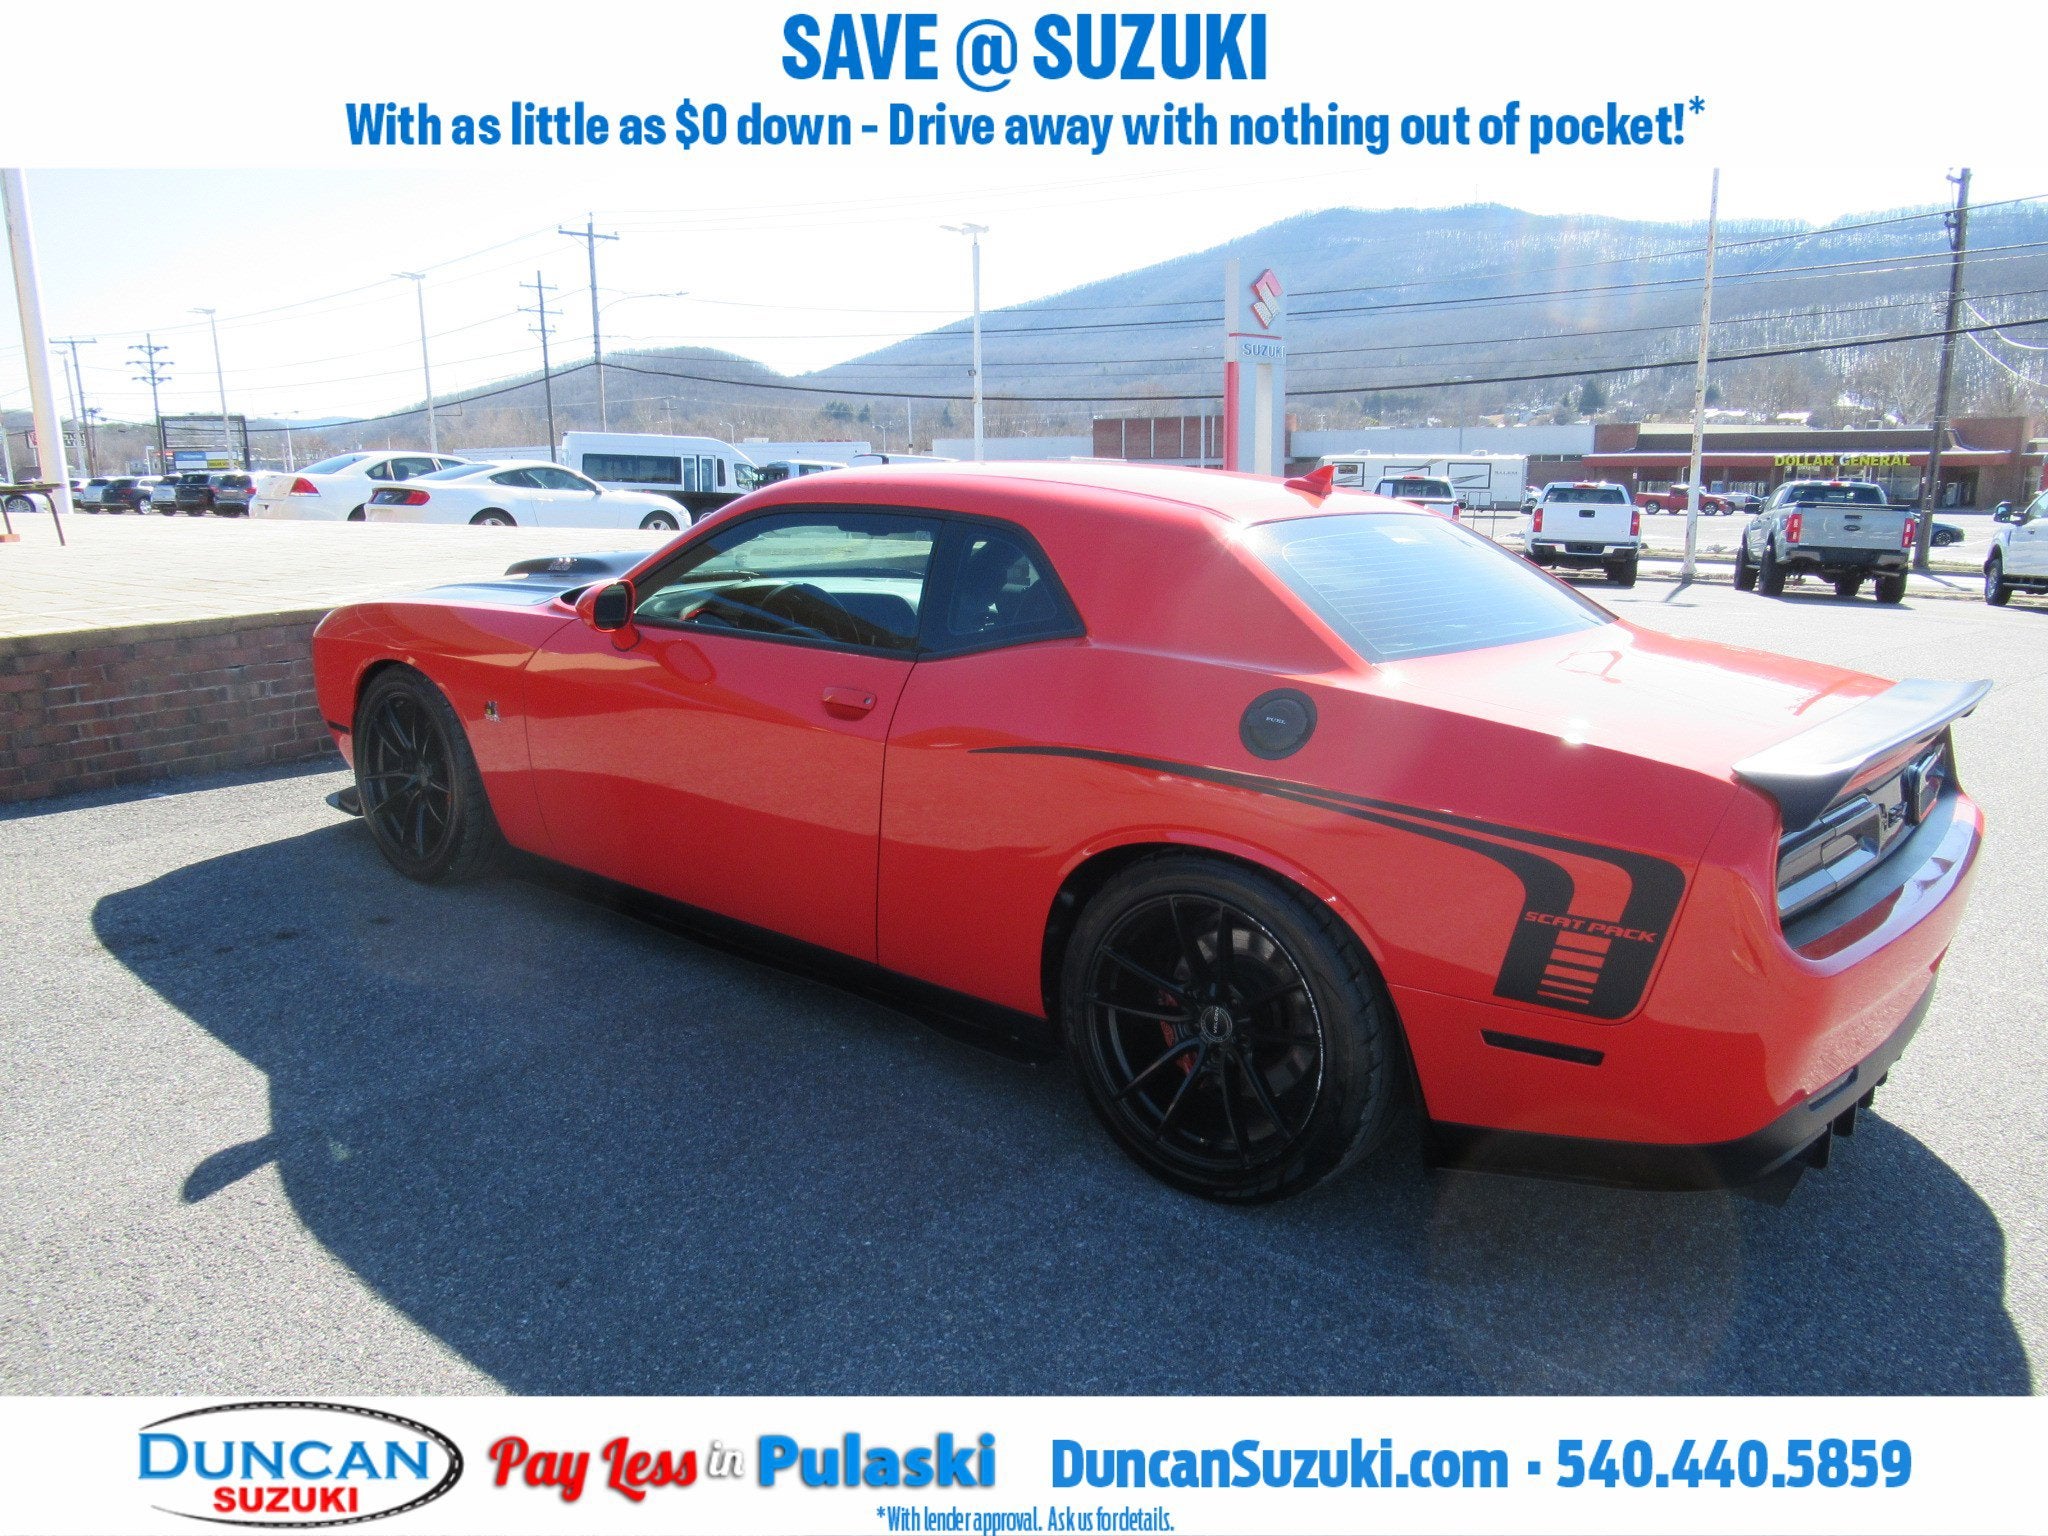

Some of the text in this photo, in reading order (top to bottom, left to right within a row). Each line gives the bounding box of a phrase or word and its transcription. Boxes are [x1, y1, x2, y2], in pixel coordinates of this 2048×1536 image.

[1243, 343, 1284, 358] SUZUKI
[1774, 454, 1910, 467] DOLLAR GENERAL
[1525, 911, 1657, 943] SCAT PACK
